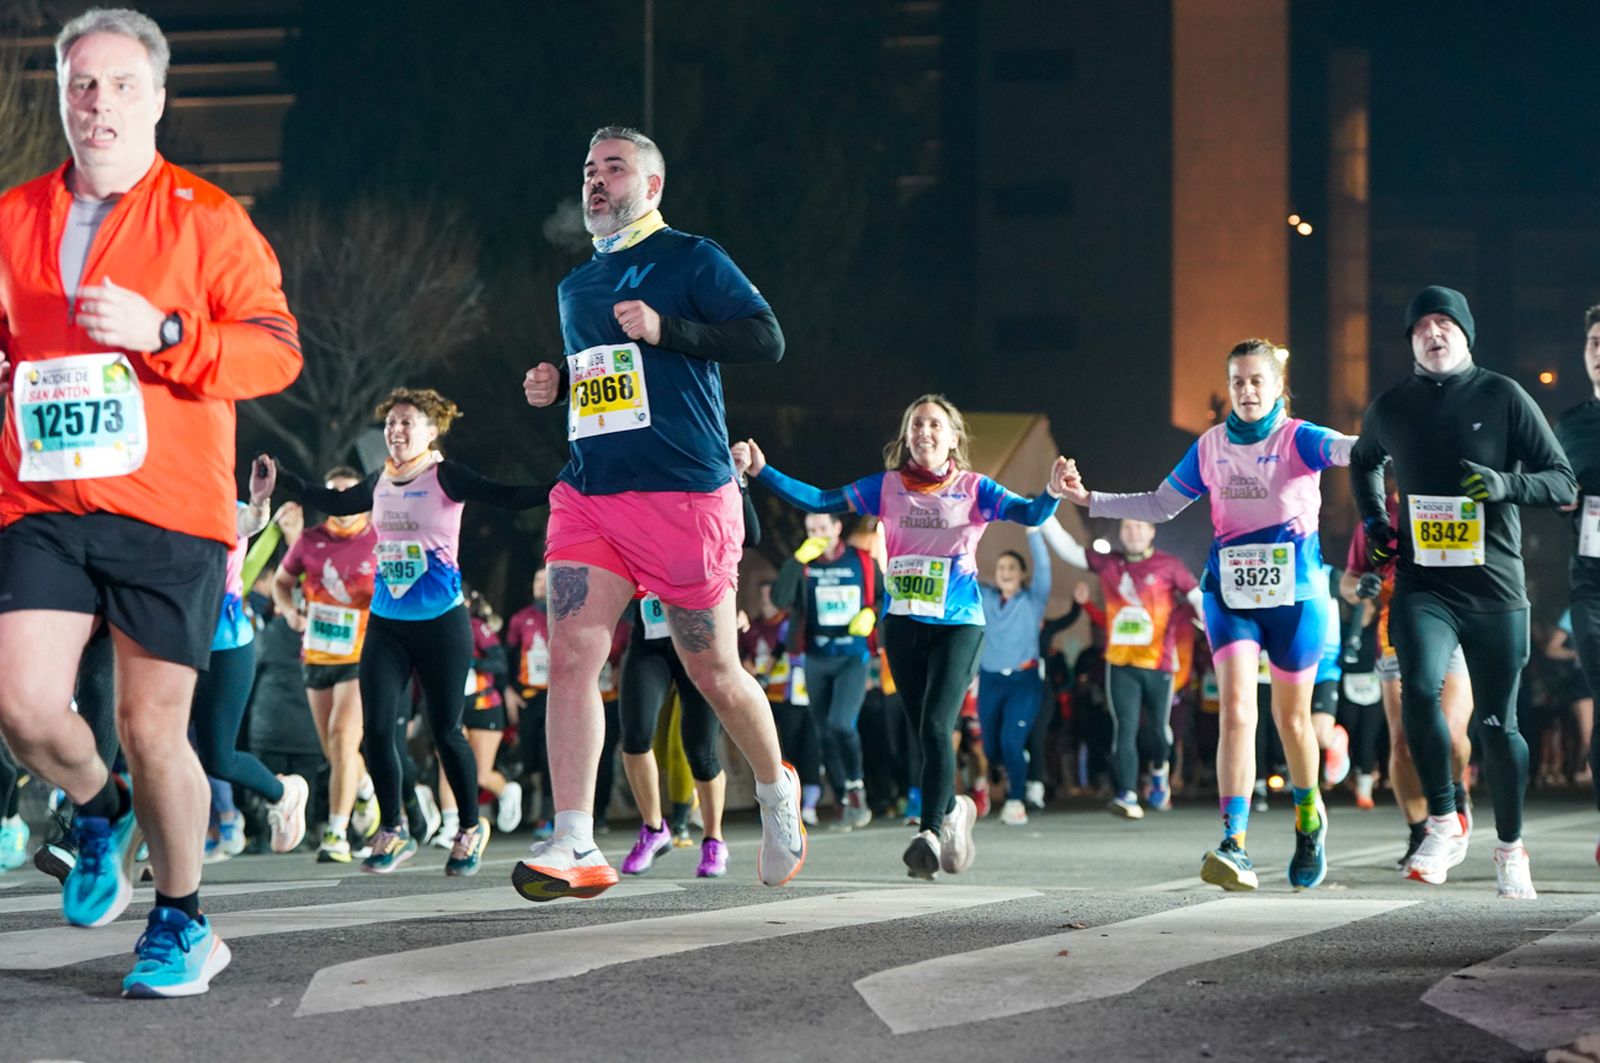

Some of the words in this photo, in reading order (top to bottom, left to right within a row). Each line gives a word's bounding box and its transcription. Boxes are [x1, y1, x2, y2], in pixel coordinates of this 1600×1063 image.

[75, 371, 89, 382] DE
[29, 389, 49, 402] SAN
[32, 399, 124, 440] 12573
[1220, 486, 1269, 500] Hualdo
[909, 506, 940, 516] Finca
[899, 516, 949, 529] Hualdo
[1420, 521, 1469, 542] 8342
[1234, 566, 1281, 587] 3523
